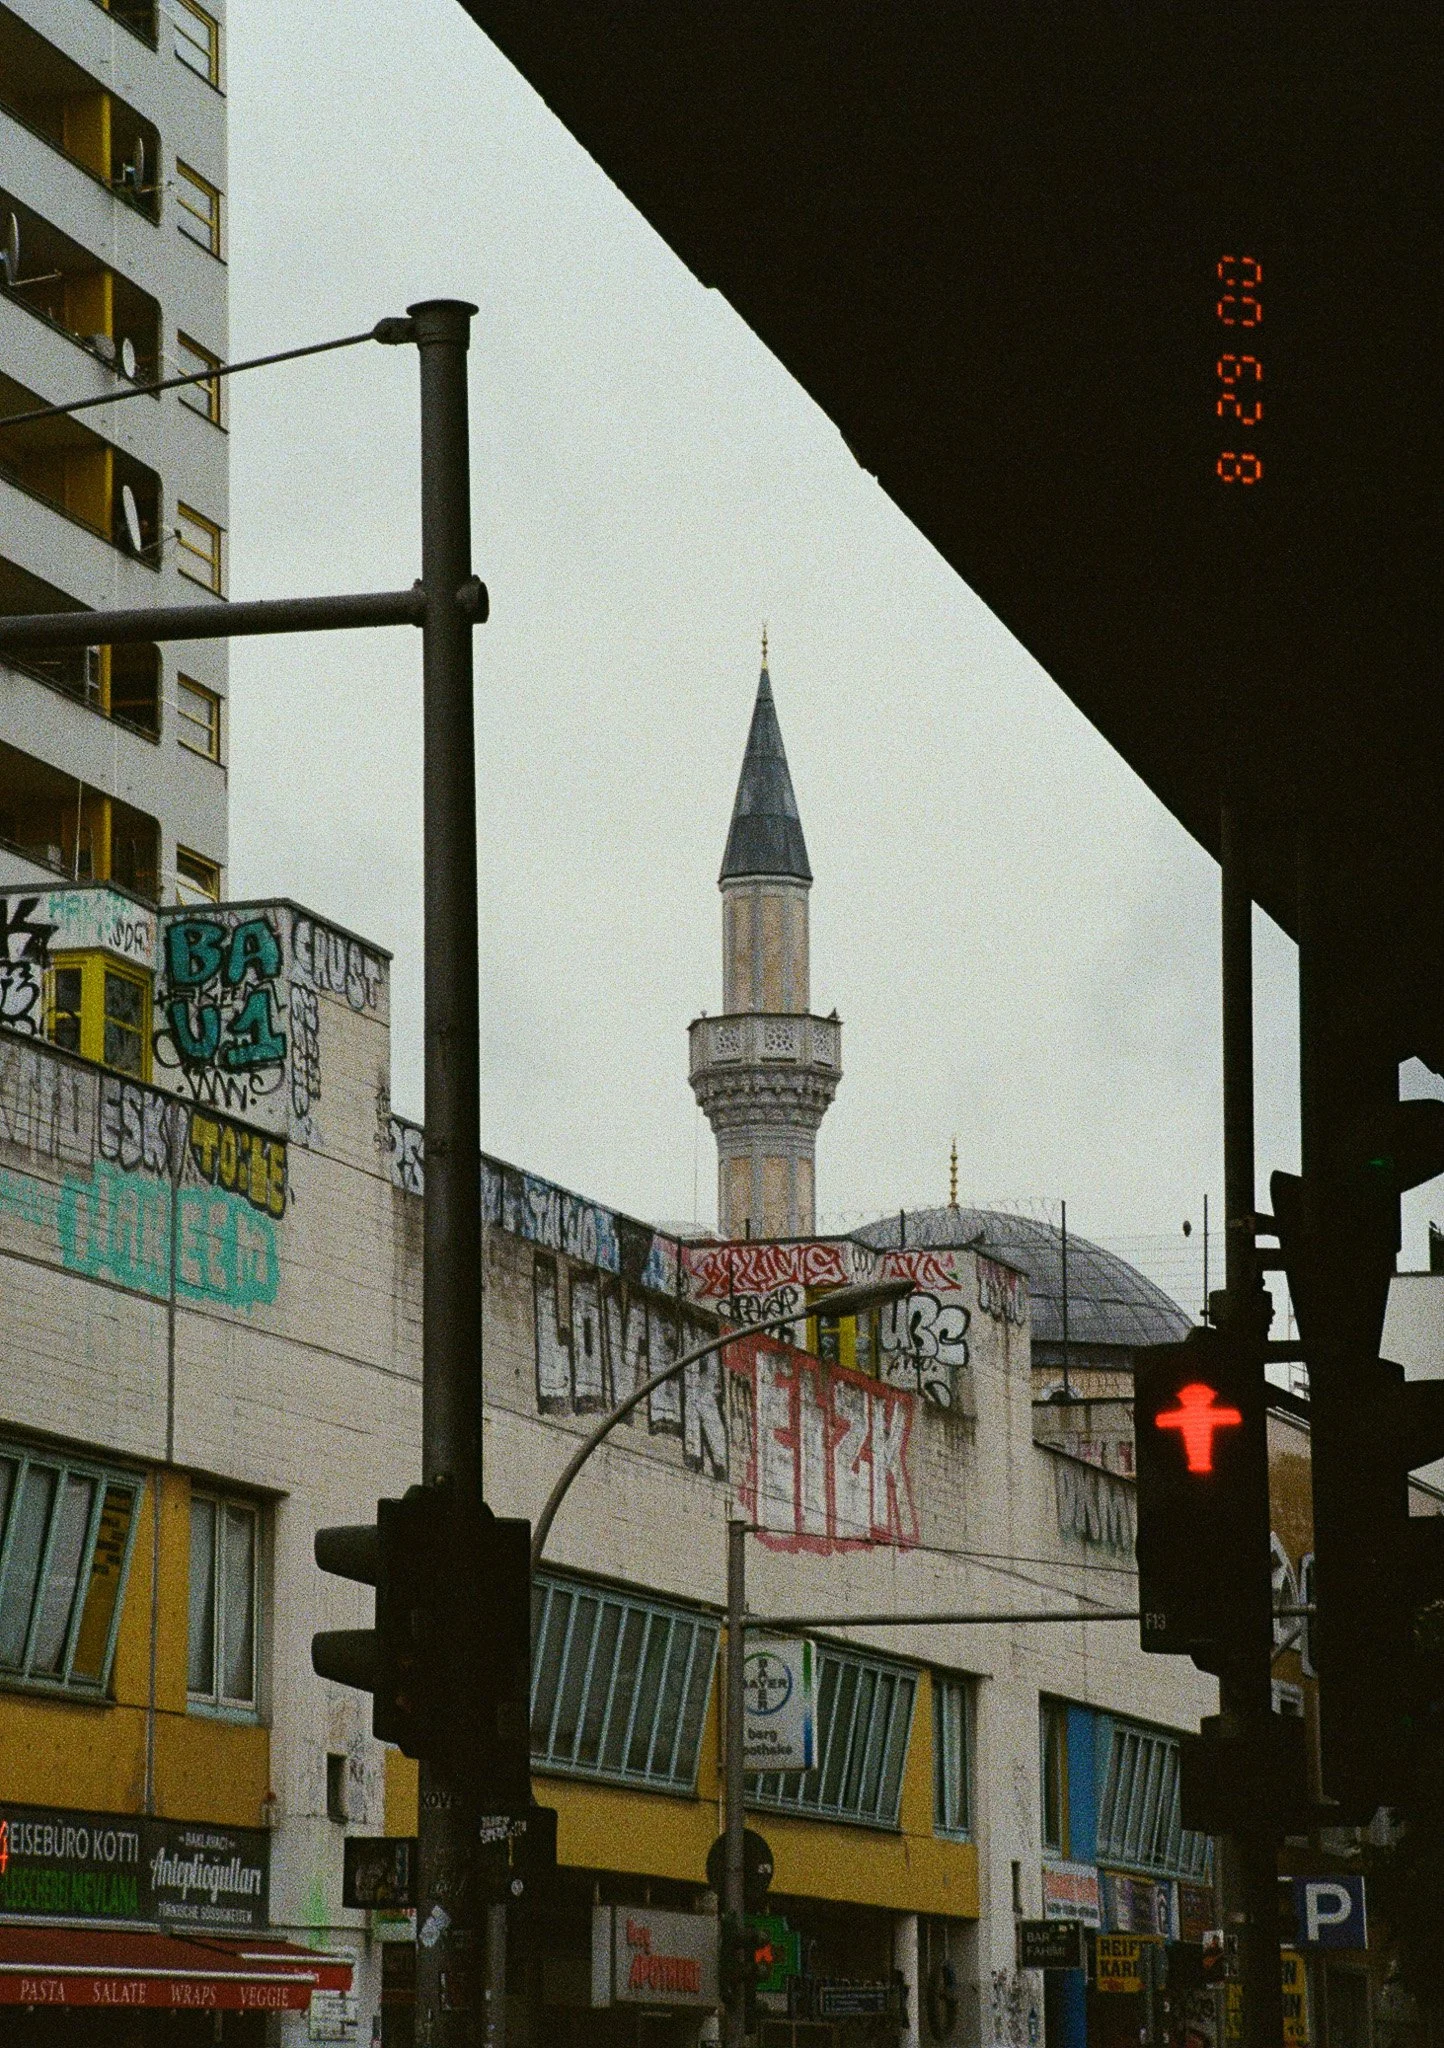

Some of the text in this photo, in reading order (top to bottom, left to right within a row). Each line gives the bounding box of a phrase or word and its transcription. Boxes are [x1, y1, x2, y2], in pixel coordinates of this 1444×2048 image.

[93, 1830, 139, 1863] KOTTI
[1304, 1882, 1353, 1942] P
[20, 1978, 290, 2008] PASTA SALATE WRAPS VEGGIE
